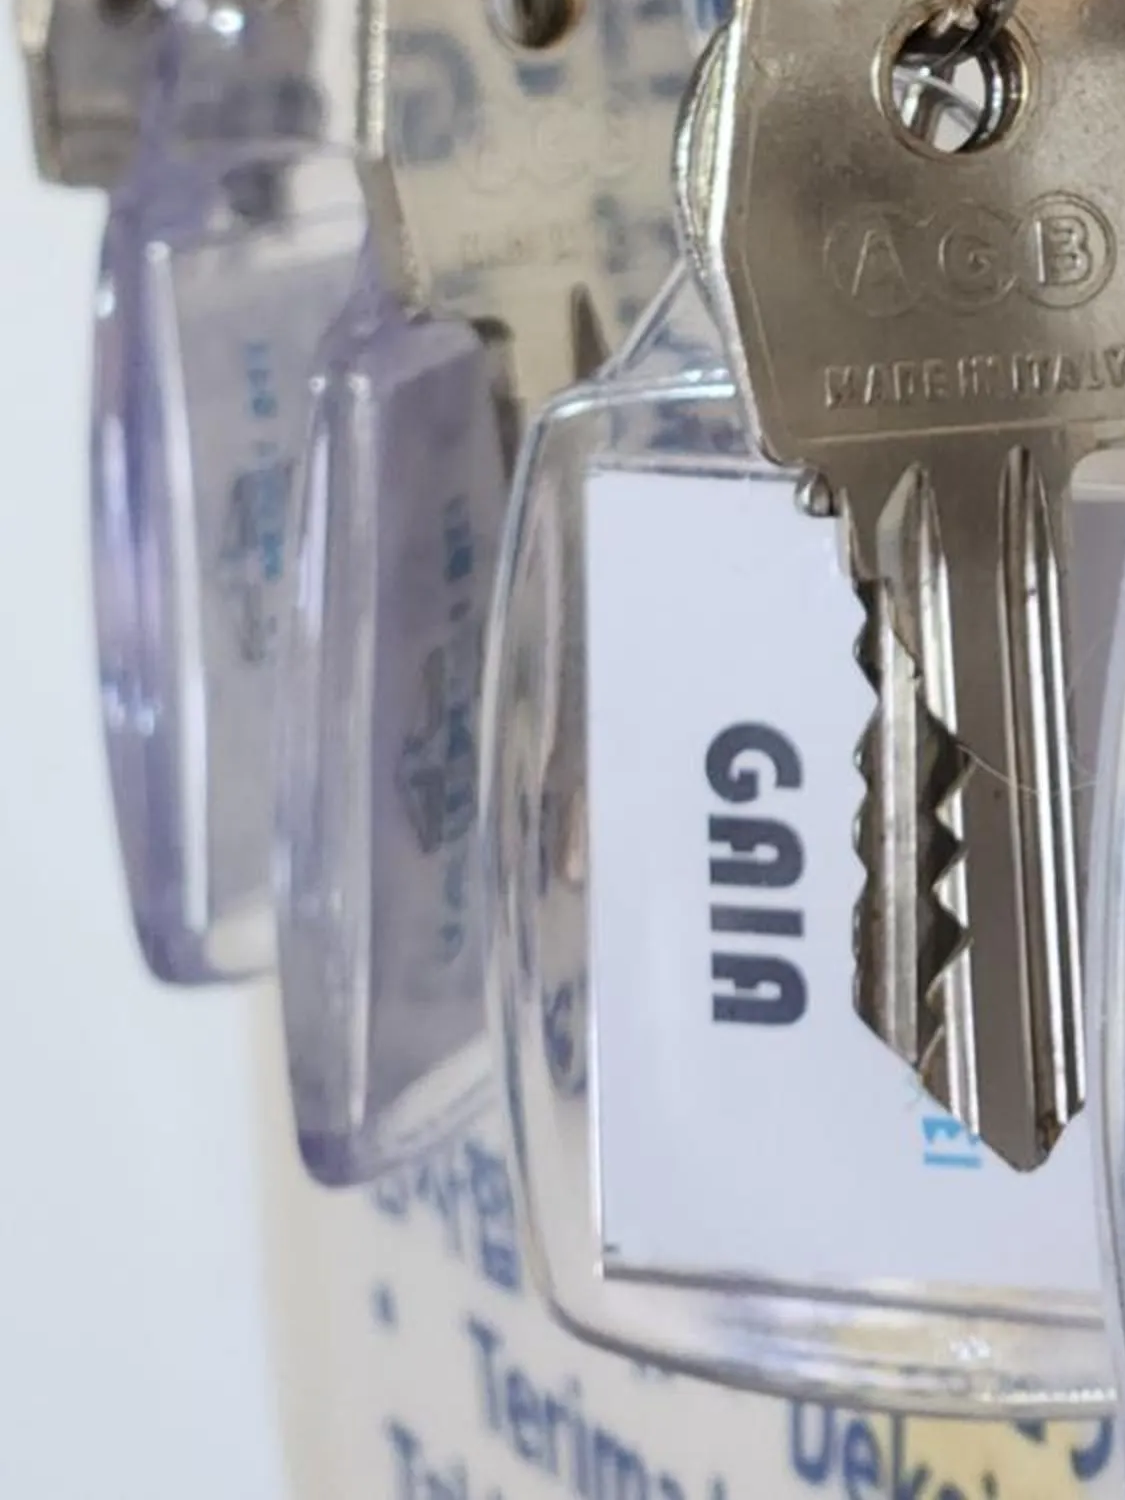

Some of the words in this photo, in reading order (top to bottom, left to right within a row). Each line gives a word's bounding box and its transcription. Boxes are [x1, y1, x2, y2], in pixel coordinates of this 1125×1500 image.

[846, 212, 1097, 301] AGB
[825, 359, 948, 405] MADE
[705, 720, 809, 1027] GAIA
